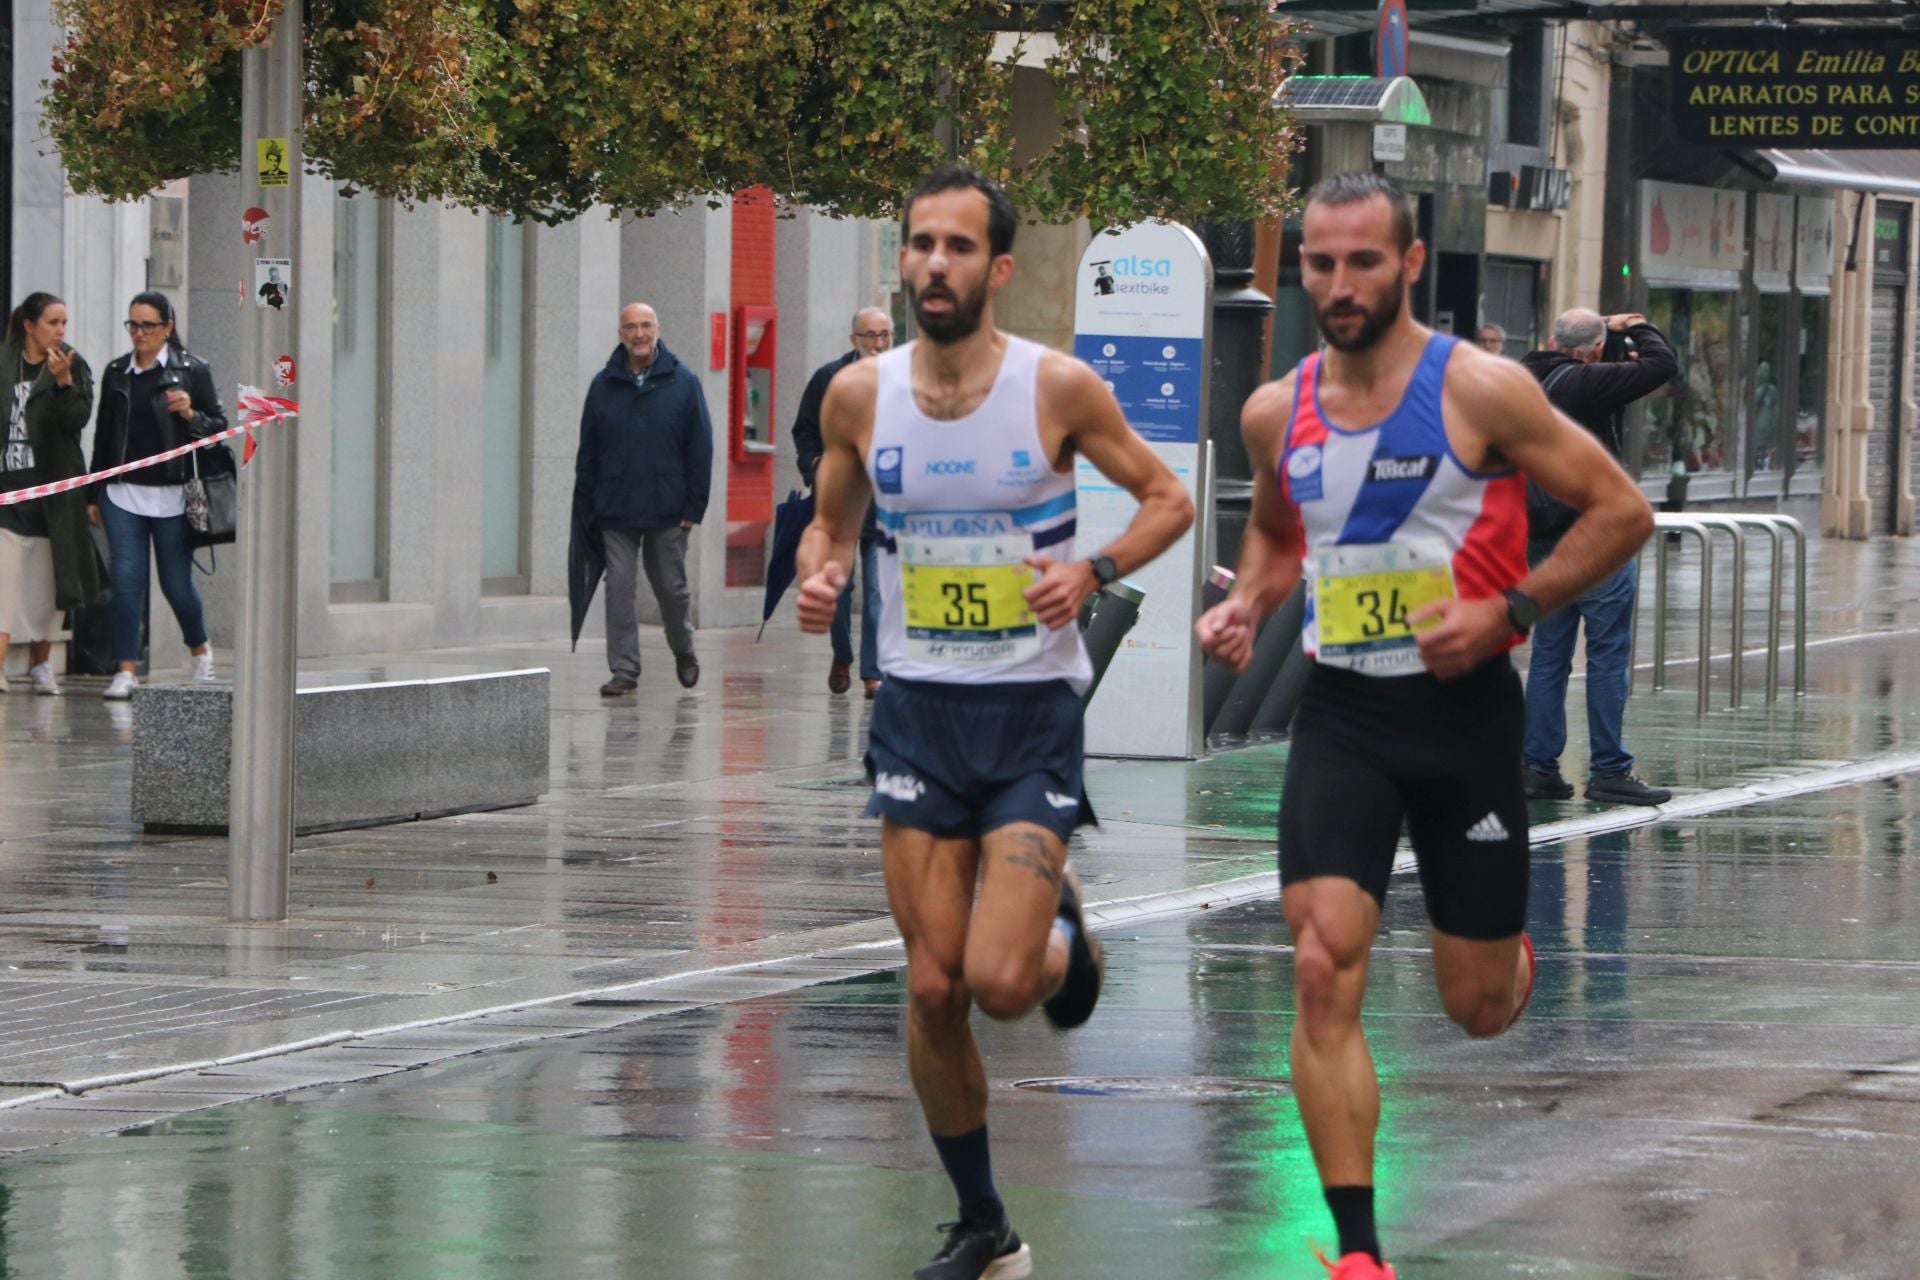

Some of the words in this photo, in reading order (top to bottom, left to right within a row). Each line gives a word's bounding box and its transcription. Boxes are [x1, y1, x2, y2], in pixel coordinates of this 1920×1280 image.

[1682, 50, 1780, 74] OPTICA
[1796, 50, 1886, 73] Emilia
[1689, 85, 1818, 104] APARATOS
[1828, 85, 1893, 104] PARA
[1905, 85, 1920, 104] S
[1710, 116, 1799, 136] LENTES
[1811, 116, 1844, 136] DE
[1855, 116, 1920, 136] CONT
[1113, 255, 1172, 277] alsa
[941, 583, 990, 626] 35
[1356, 588, 1411, 637] 34
